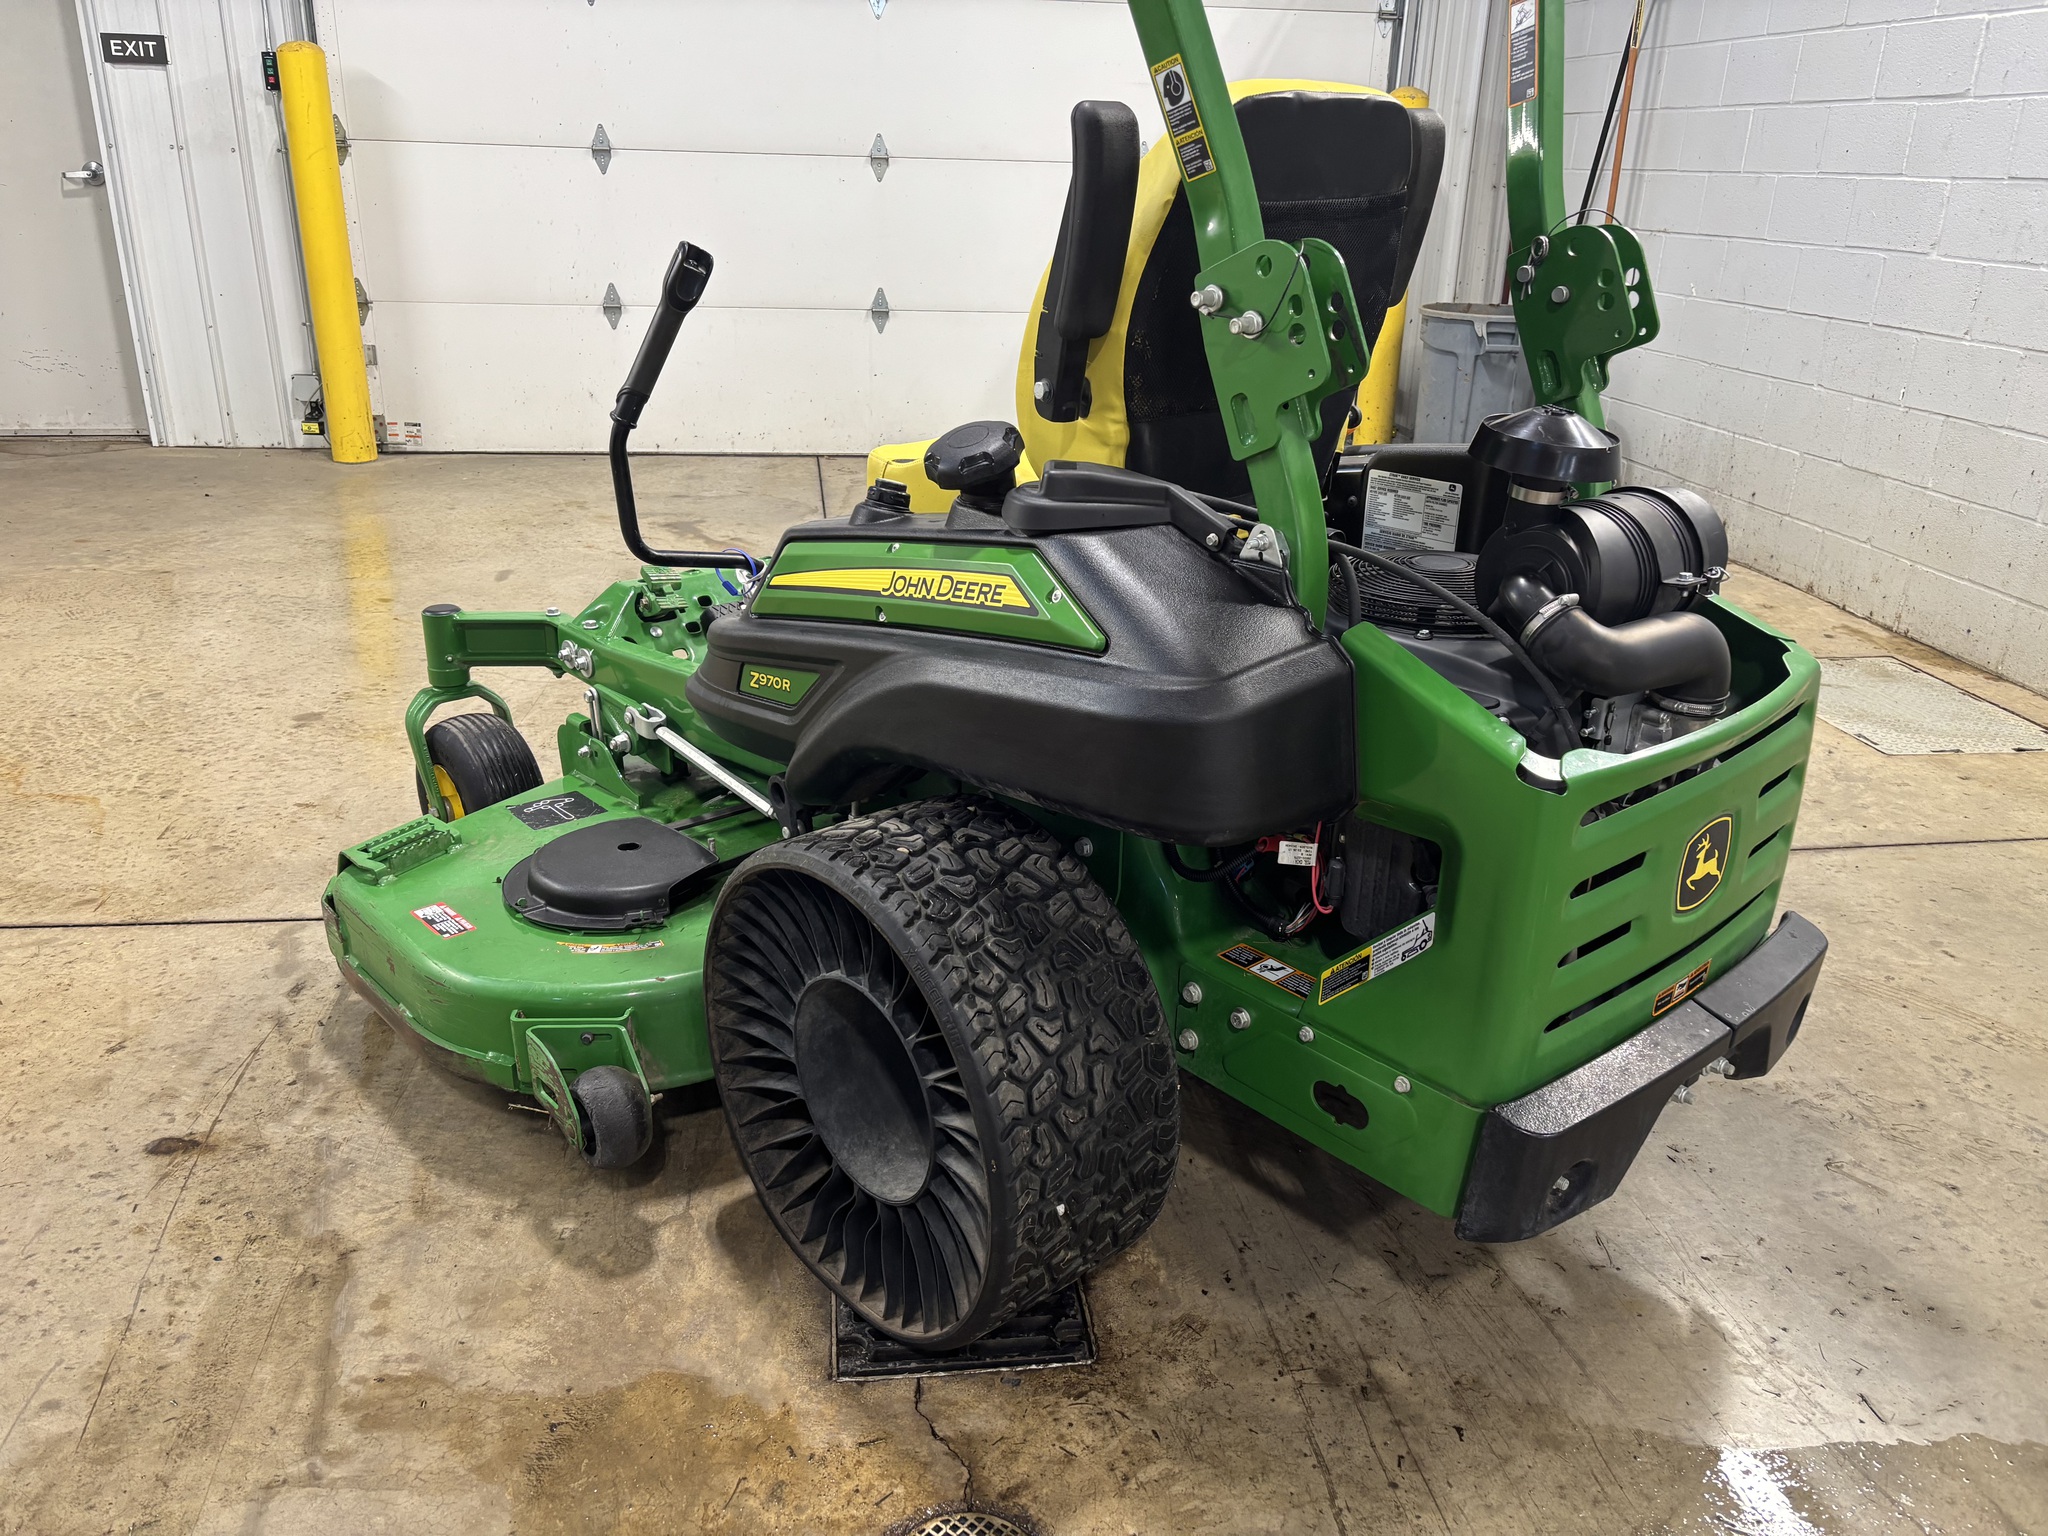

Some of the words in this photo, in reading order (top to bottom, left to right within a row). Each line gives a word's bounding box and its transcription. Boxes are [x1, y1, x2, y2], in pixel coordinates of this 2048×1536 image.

[110, 40, 157, 57] EXIT
[1157, 56, 1179, 72] CAUTION
[882, 571, 935, 596] JOHN
[936, 575, 1007, 604] DEERE
[749, 671, 791, 692] Z970R
[912, 961, 944, 1009] TWEEL
